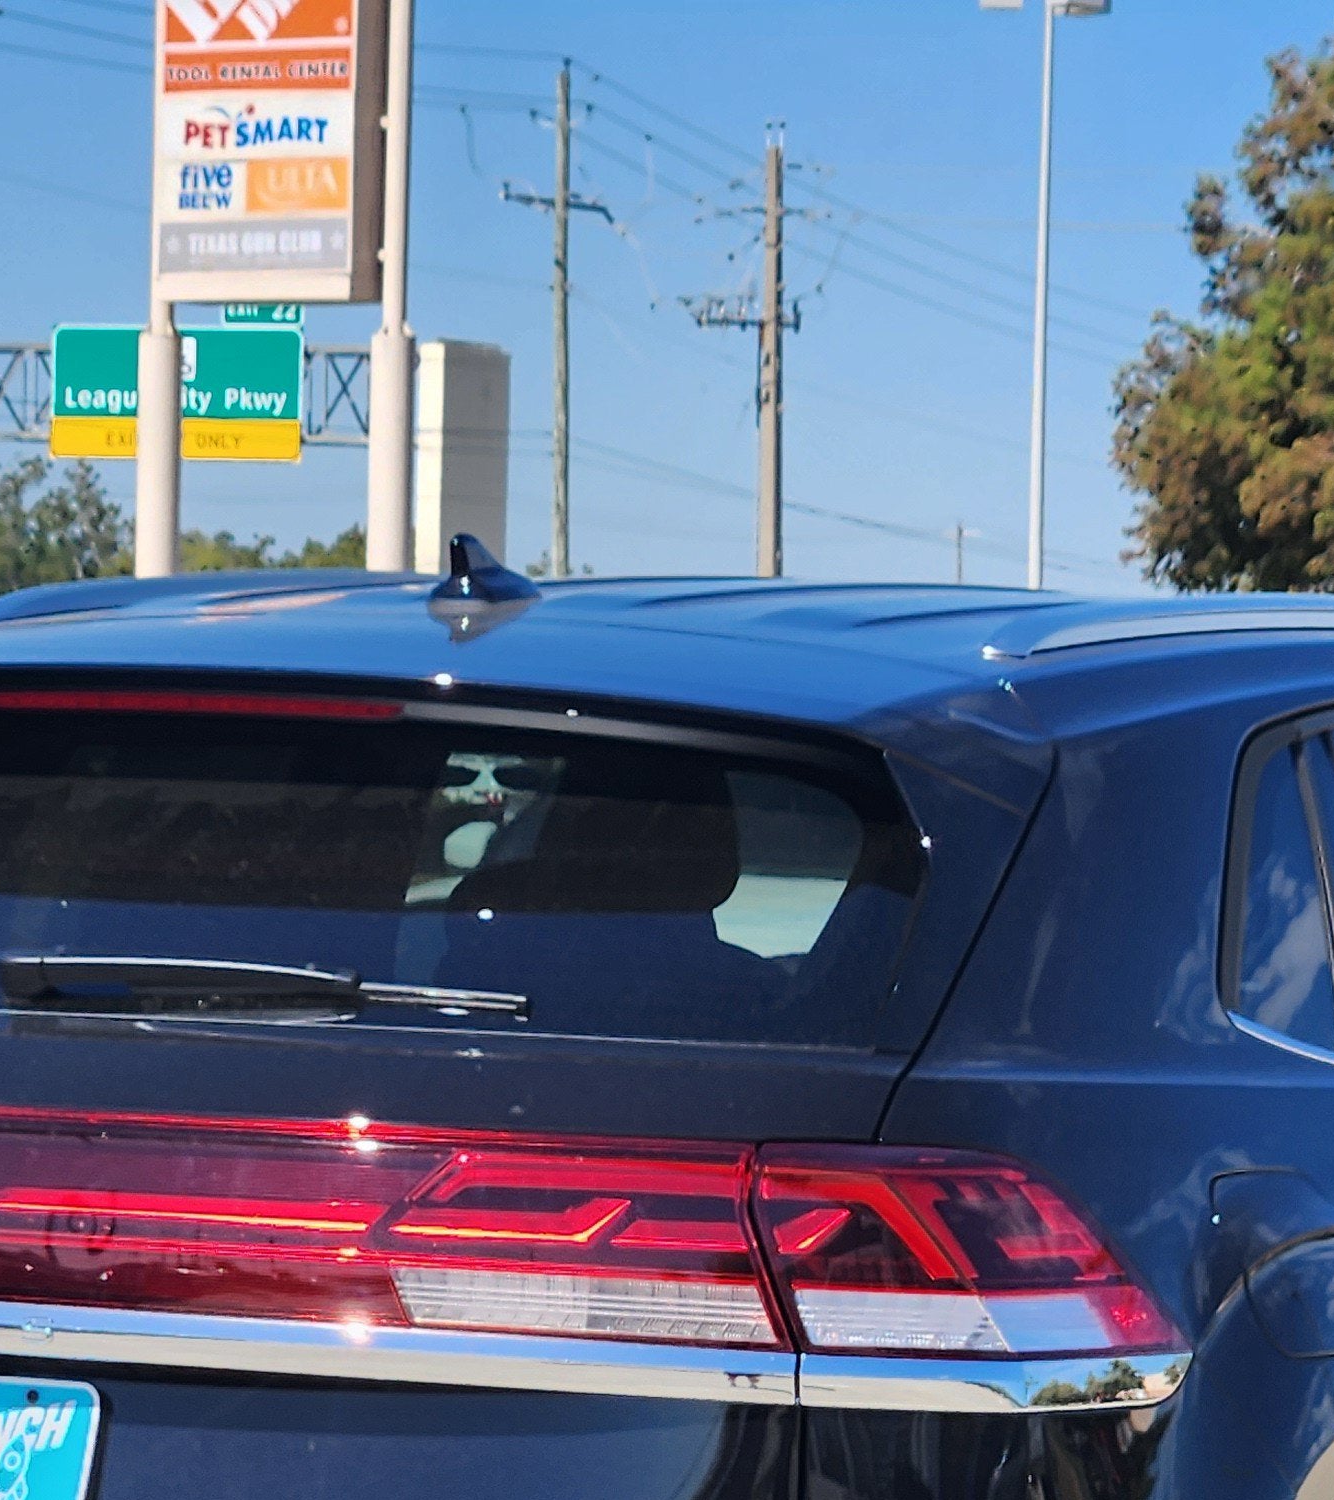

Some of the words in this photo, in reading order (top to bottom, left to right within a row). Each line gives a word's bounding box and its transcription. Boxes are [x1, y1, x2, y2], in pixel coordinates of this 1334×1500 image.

[167, 66, 210, 82] TOOL
[220, 63, 280, 80] RENTAL
[288, 61, 348, 78] CENTER
[180, 163, 233, 190] five
[65, 386, 137, 414] Leagu
[181, 384, 212, 415] ity
[224, 387, 287, 416] Pkwy
[106, 432, 135, 448] EXI
[196, 433, 244, 449] ONLY
